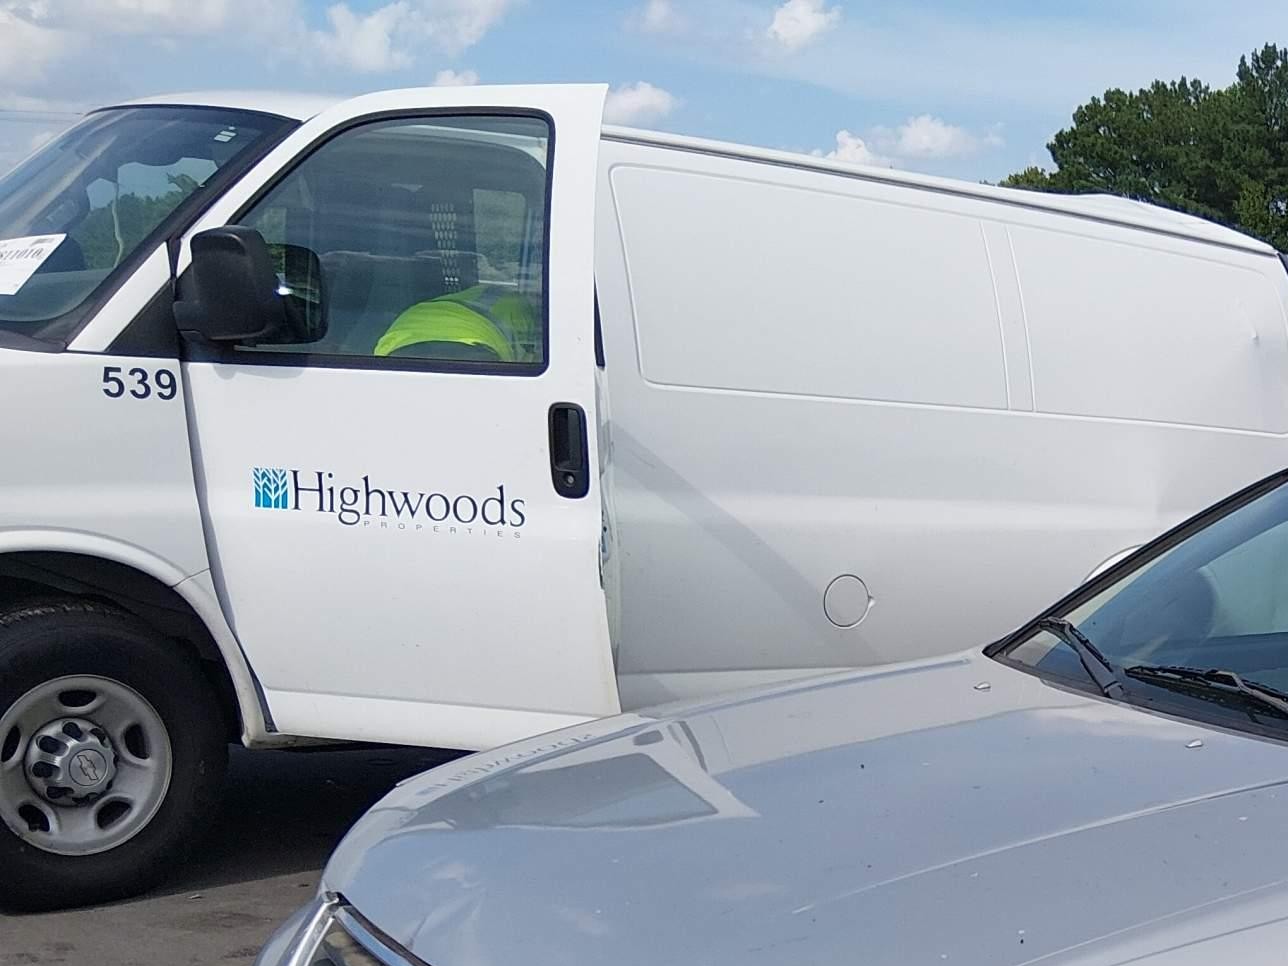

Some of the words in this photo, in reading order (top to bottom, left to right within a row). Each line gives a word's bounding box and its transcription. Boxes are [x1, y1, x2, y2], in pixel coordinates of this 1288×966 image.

[103, 366, 177, 400] 539
[291, 470, 525, 526] Highwoods
[363, 520, 521, 539] PROPERTIES
